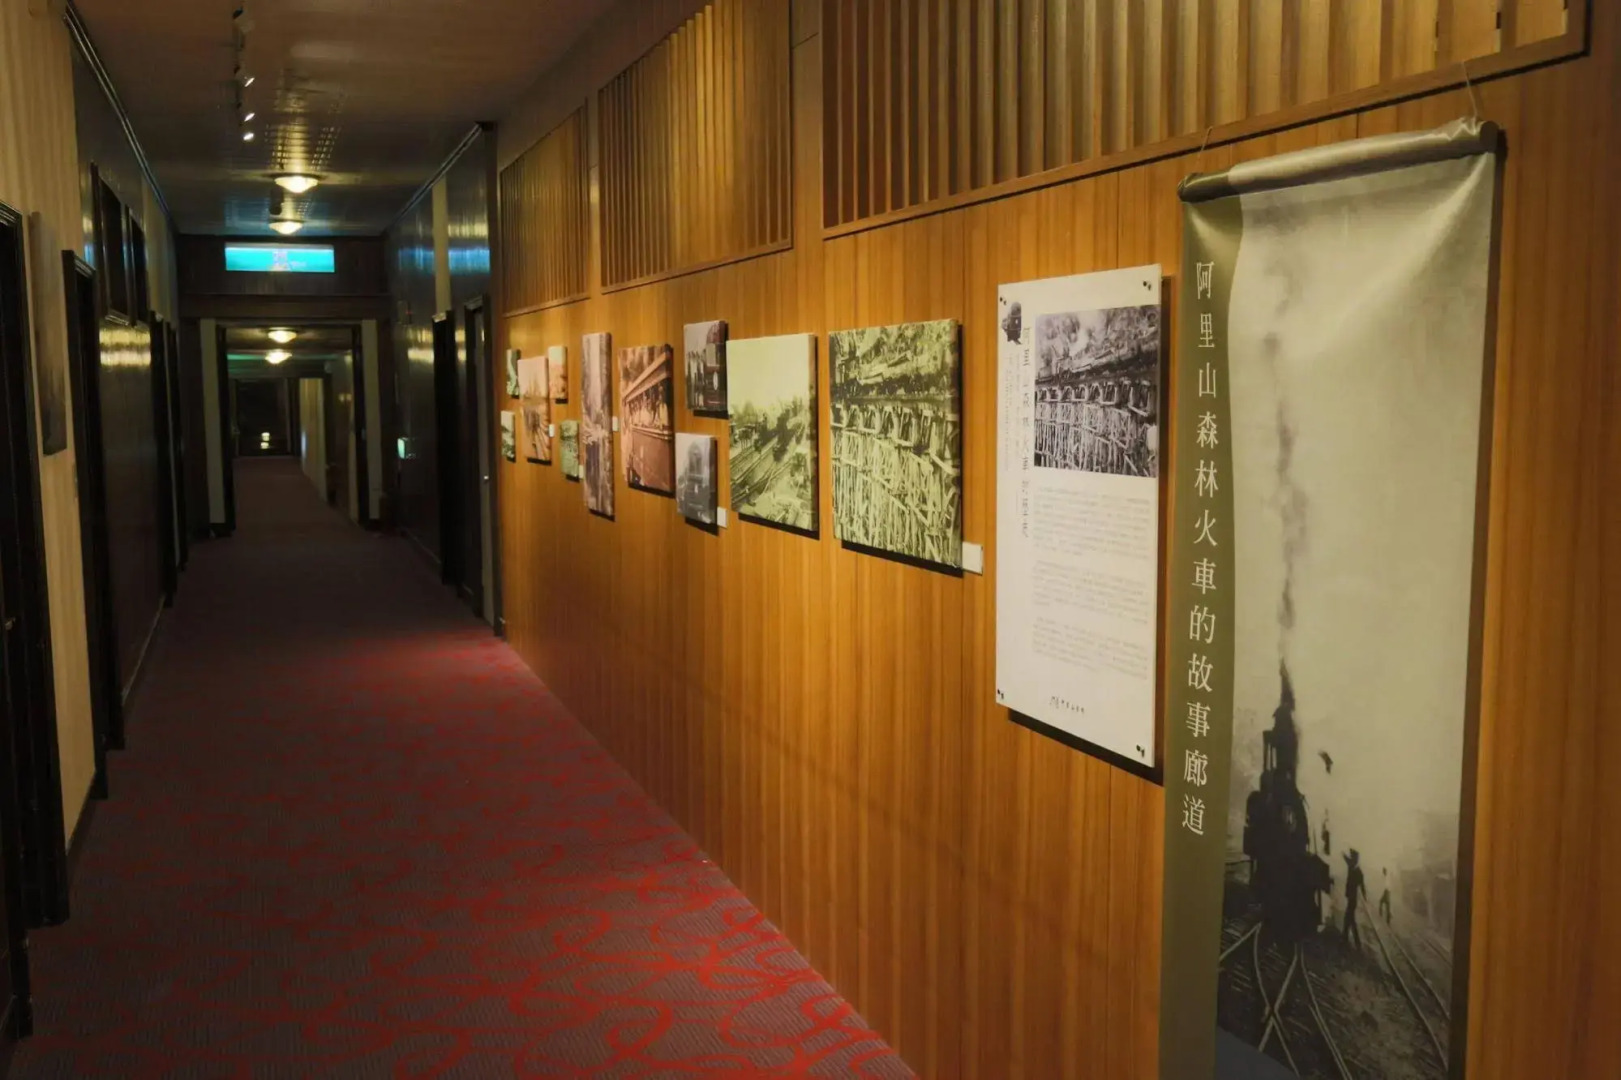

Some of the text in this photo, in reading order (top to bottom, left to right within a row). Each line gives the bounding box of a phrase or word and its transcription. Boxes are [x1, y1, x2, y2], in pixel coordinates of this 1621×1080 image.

[1181, 260, 1219, 836] 阿里山森林火車的故事廊道
